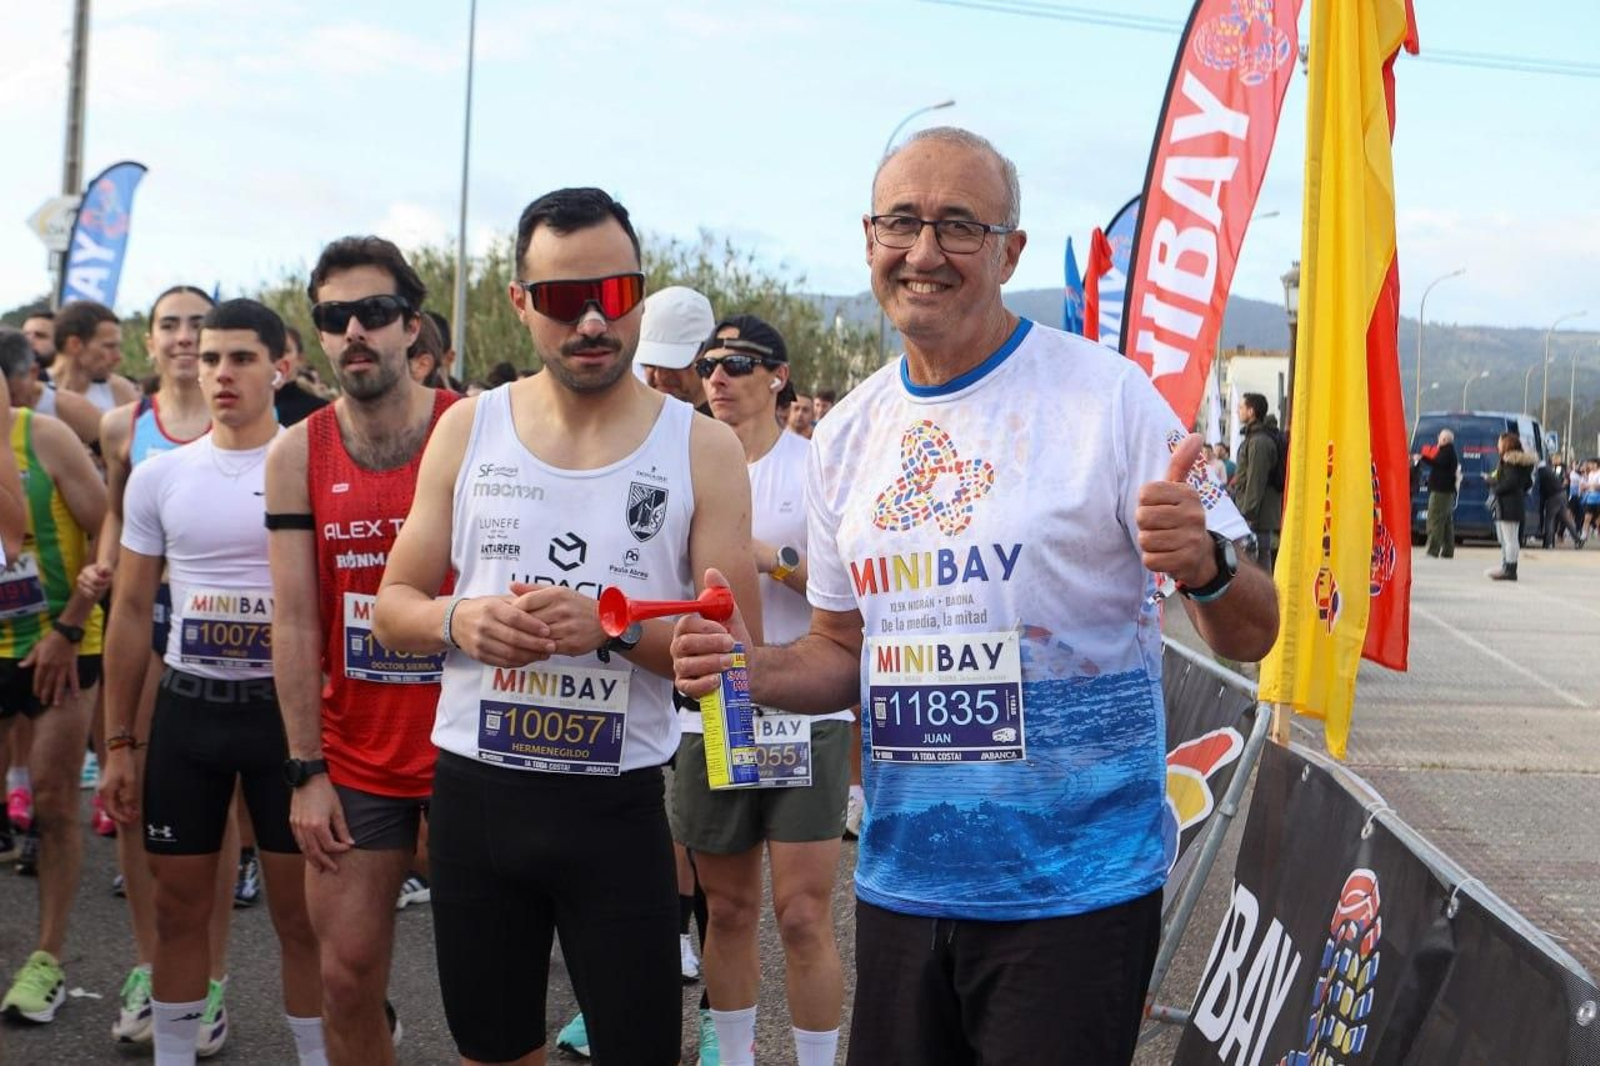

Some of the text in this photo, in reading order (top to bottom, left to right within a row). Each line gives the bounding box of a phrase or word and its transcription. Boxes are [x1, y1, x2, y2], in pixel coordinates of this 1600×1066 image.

[65, 230, 115, 305] AY
[324, 519, 382, 540] ALEX
[850, 544, 1023, 597] MINIBAY
[200, 622, 272, 647] 10073
[881, 608, 988, 633] De la media, la mitad
[877, 642, 1003, 673] MINIBAY
[162, 671, 276, 703] OUR
[492, 667, 617, 701] MINIBAY
[890, 689, 999, 726] 11835
[504, 707, 606, 744] 10057
[922, 733, 951, 743] JUAN
[512, 743, 590, 759] HERMENEGILDO
[1190, 880, 1301, 1066] BAY
